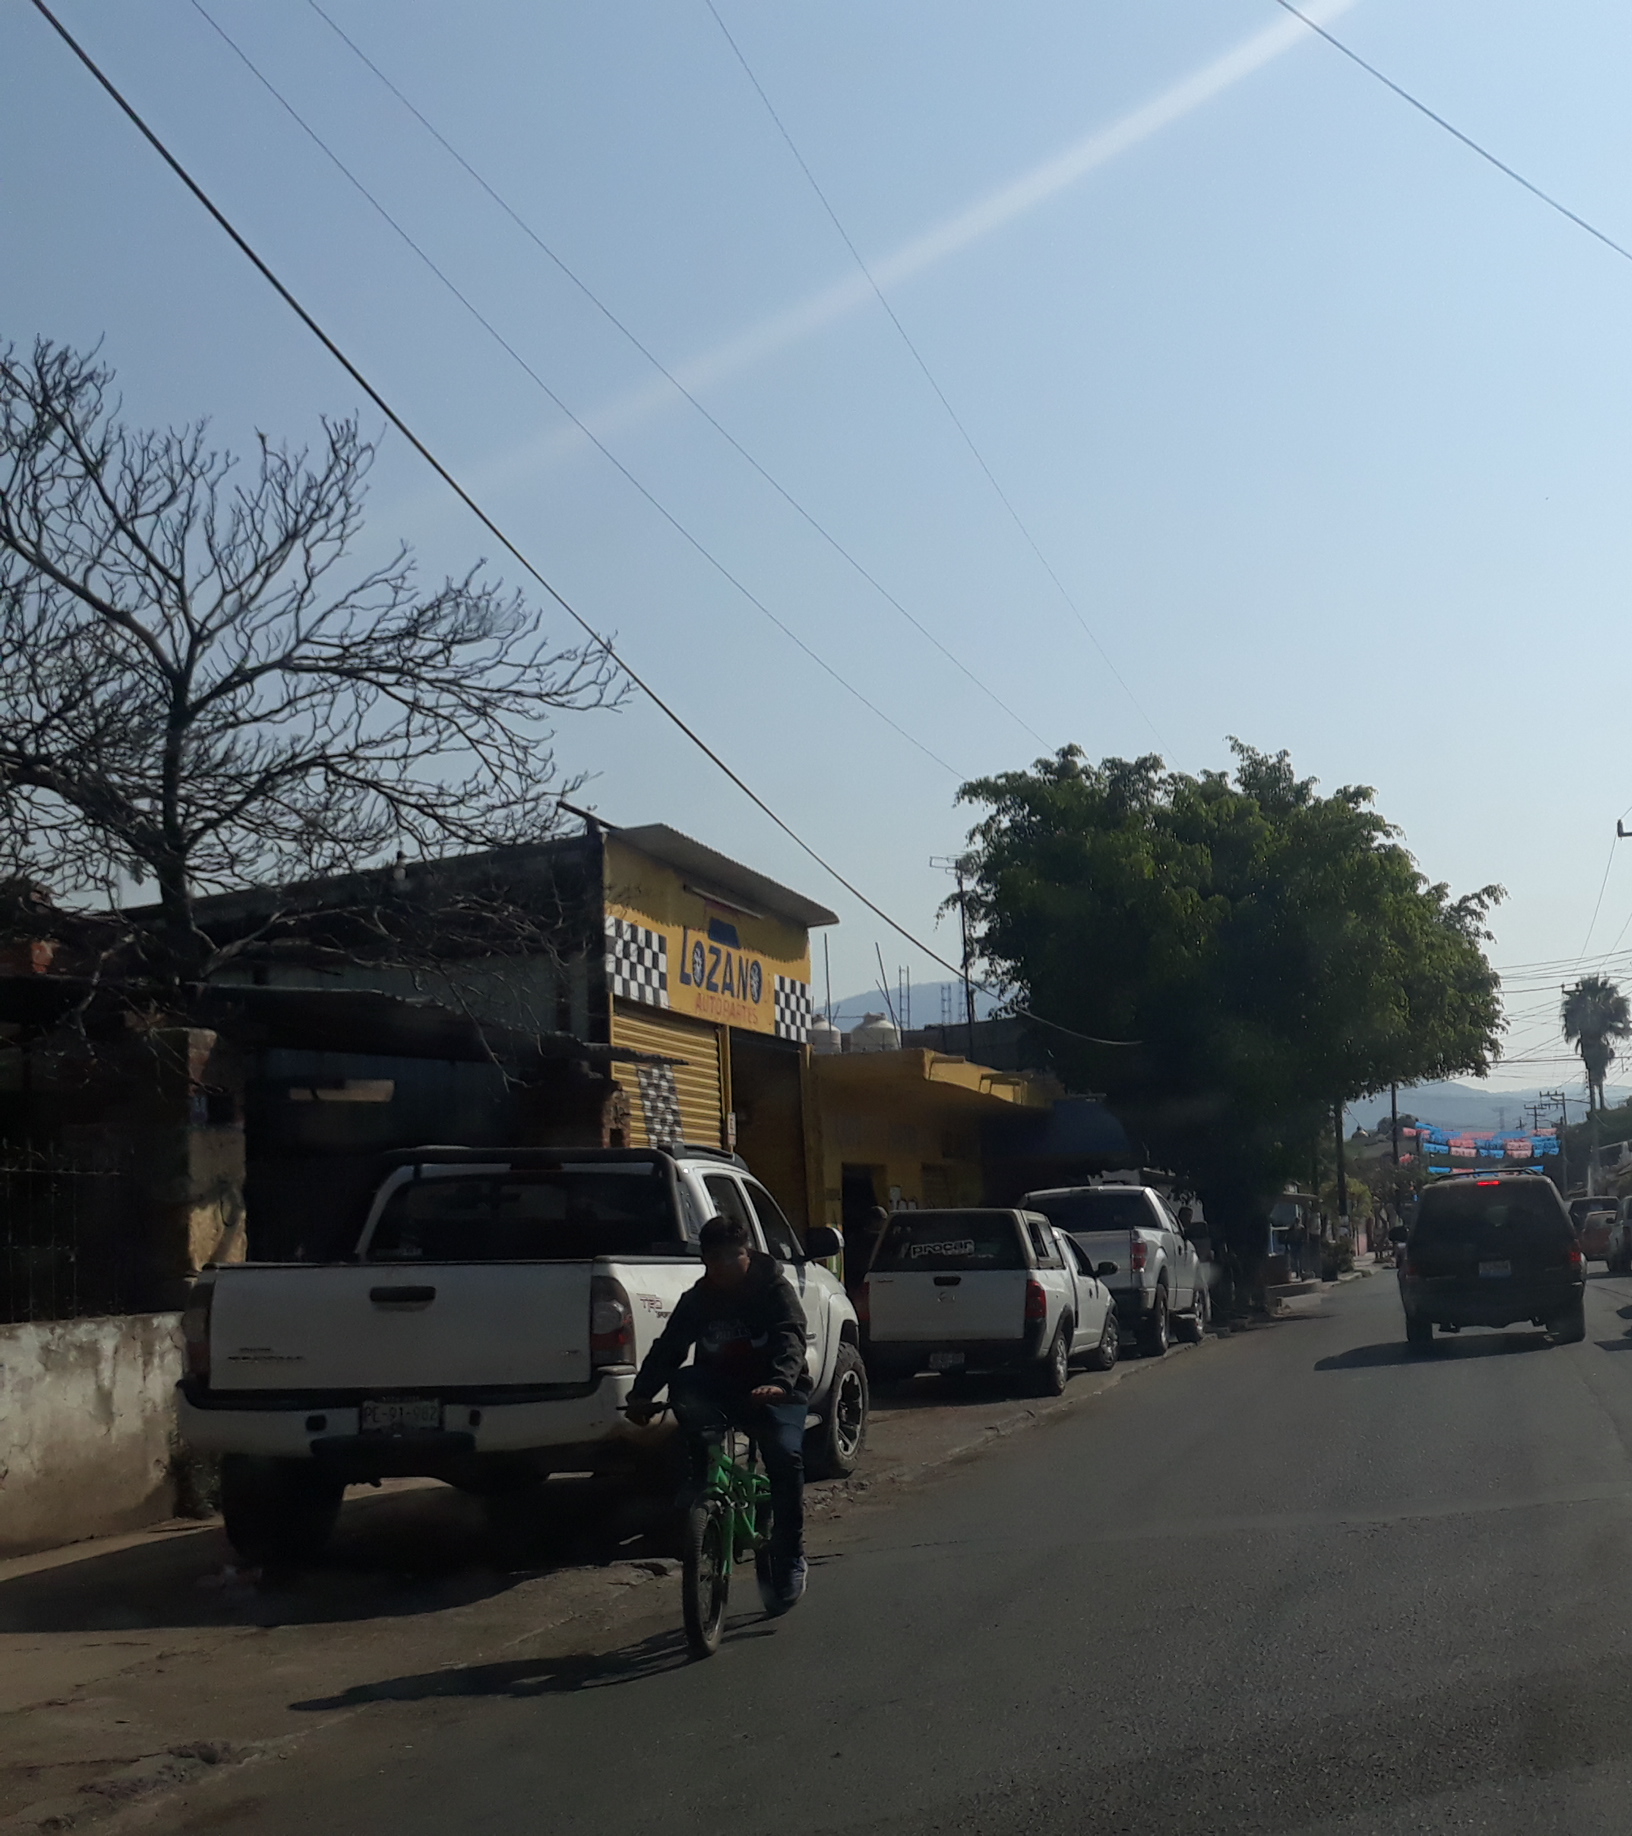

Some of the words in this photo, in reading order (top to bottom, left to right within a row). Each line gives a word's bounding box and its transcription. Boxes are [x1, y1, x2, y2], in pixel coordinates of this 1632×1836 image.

[680, 926, 762, 1004] LOZANO
[695, 993, 758, 1024] AUTOPARTES
[911, 1241, 974, 1258] procar
